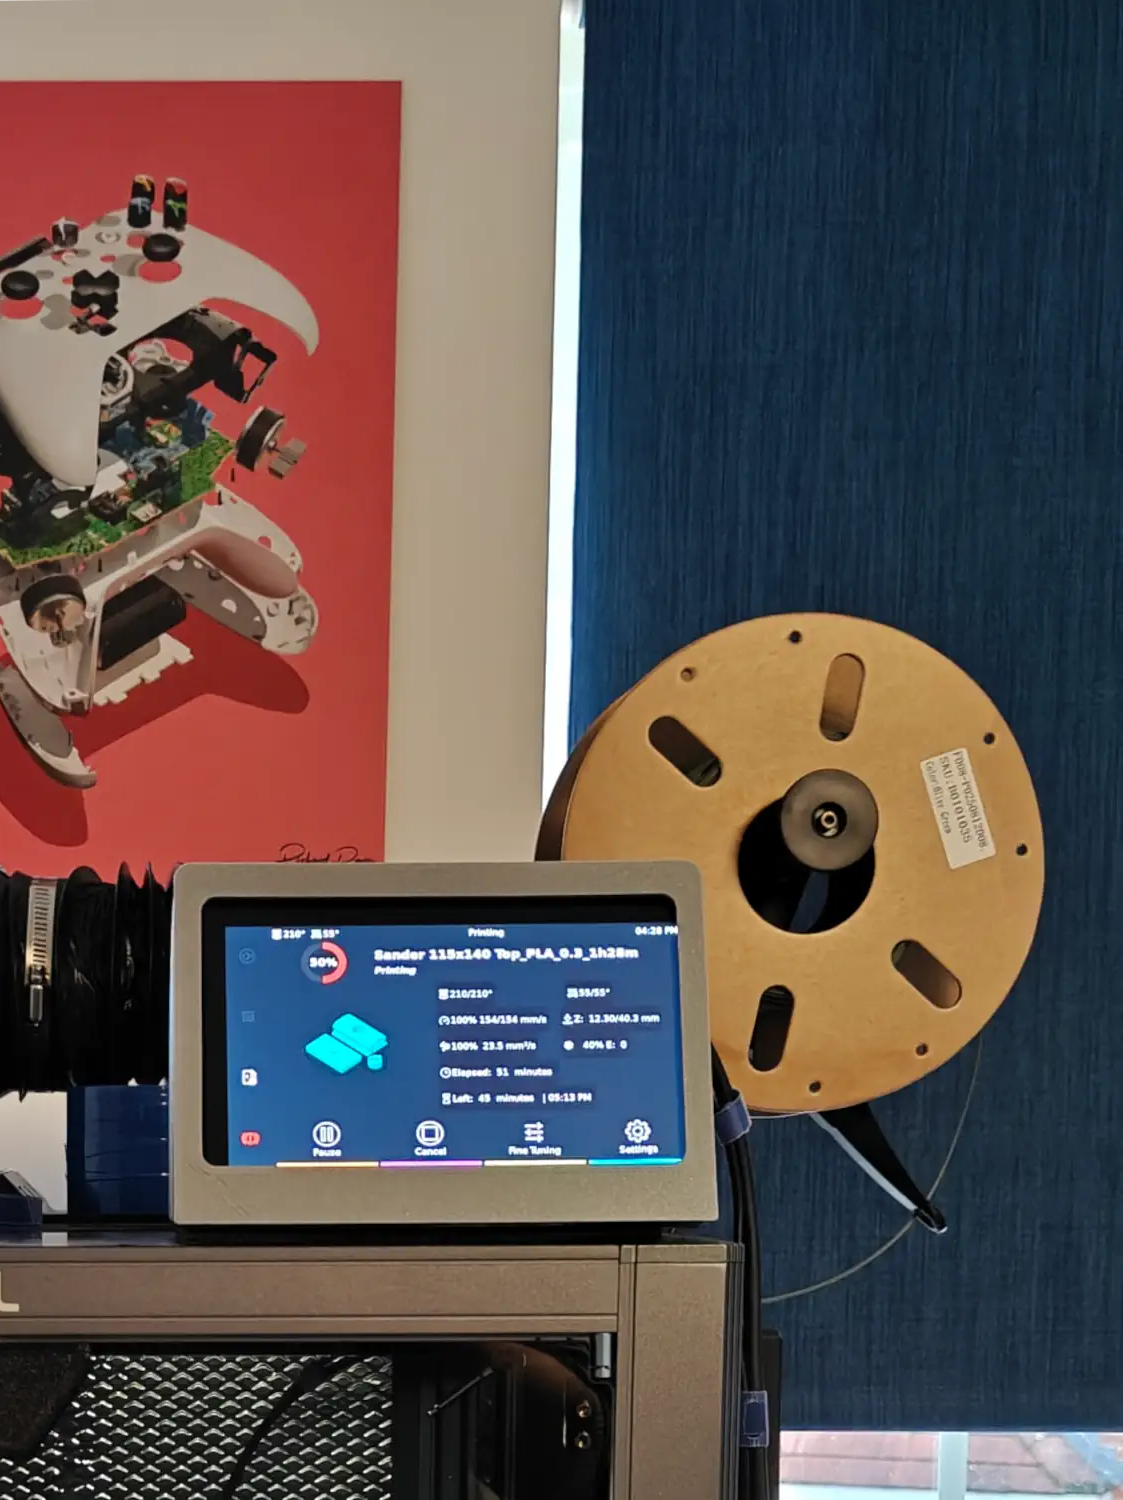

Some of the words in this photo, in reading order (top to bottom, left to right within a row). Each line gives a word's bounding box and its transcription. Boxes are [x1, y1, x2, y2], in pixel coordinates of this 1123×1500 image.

[468, 927, 505, 939] Printing
[664, 925, 678, 936] PM
[374, 949, 426, 961] Sander
[374, 965, 417, 976] Printing
[519, 1015, 548, 1025] mm/s
[640, 1014, 660, 1023] mm
[452, 1067, 492, 1078] Elapsed:
[514, 1067, 553, 1077] minutes
[495, 1093, 535, 1103] minutes
[576, 1092, 593, 1102] PM
[313, 1147, 342, 1157] Pause
[414, 1146, 447, 1156] Cancel
[508, 1145, 529, 1155] Fine
[529, 1145, 562, 1156] Tuning
[619, 1144, 658, 1155] Settings
